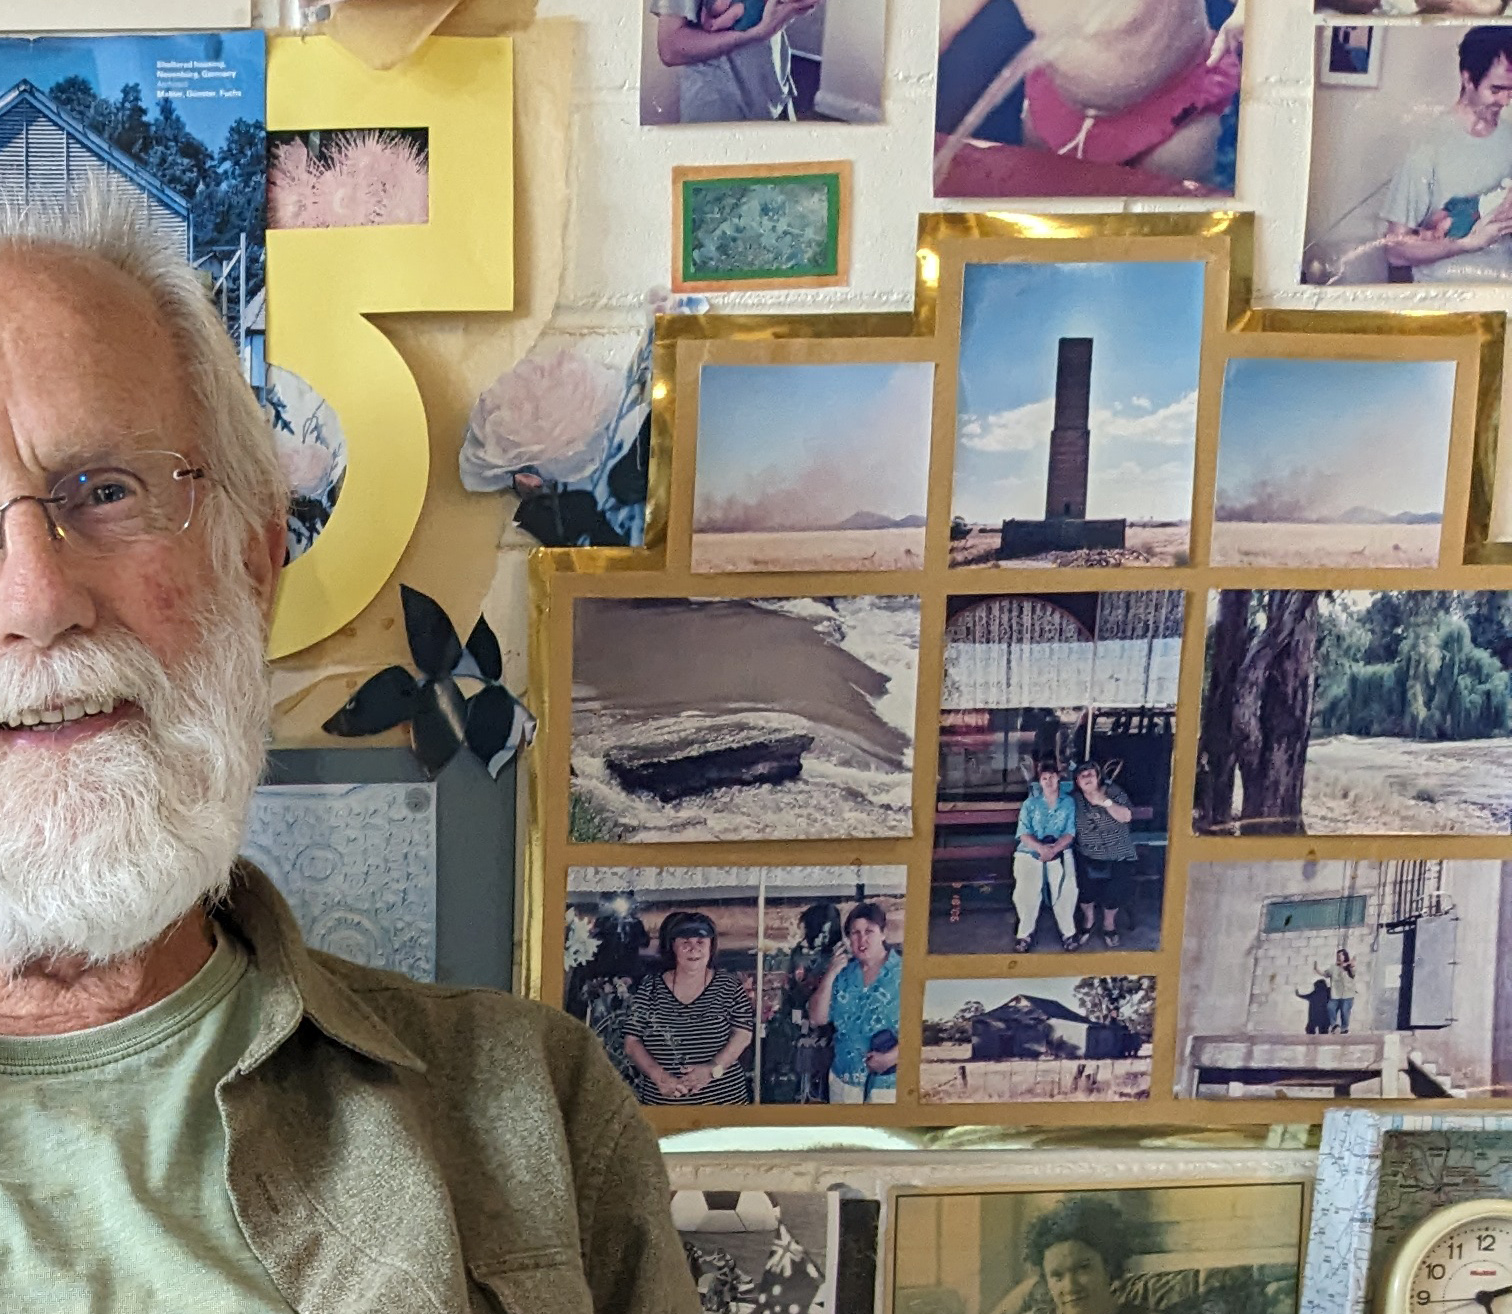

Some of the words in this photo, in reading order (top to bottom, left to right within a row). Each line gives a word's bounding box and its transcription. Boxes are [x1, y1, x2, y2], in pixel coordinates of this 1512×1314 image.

[201, 70, 237, 79] Germany
[1448, 1242, 1463, 1260] 11
[1476, 1234, 1496, 1252] 12
[1425, 1263, 1446, 1280] 10
[1416, 1290, 1431, 1306] 9
